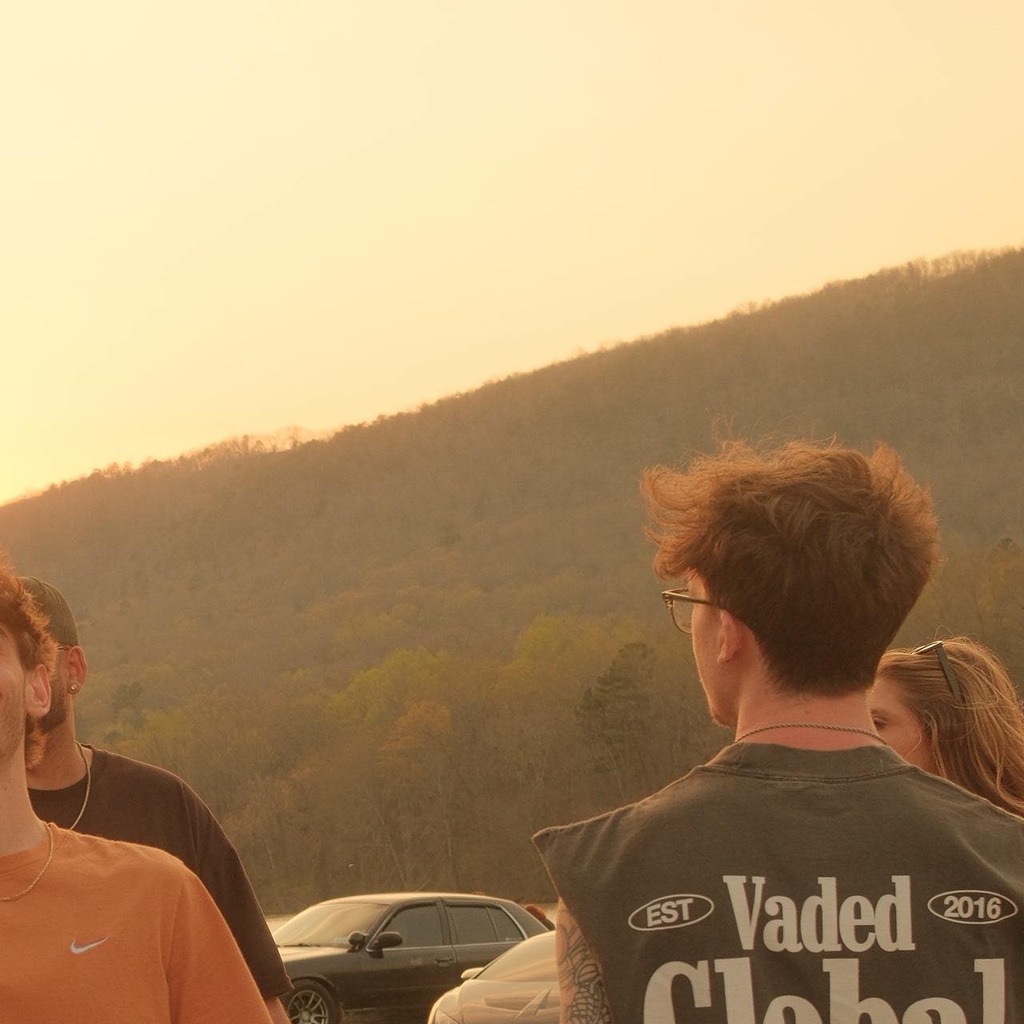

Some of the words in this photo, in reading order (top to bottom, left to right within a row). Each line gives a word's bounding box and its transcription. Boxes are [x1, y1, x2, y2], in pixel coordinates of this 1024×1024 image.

[646, 898, 695, 927] EST
[723, 875, 916, 954] Vaded
[943, 895, 1001, 920] 2016
